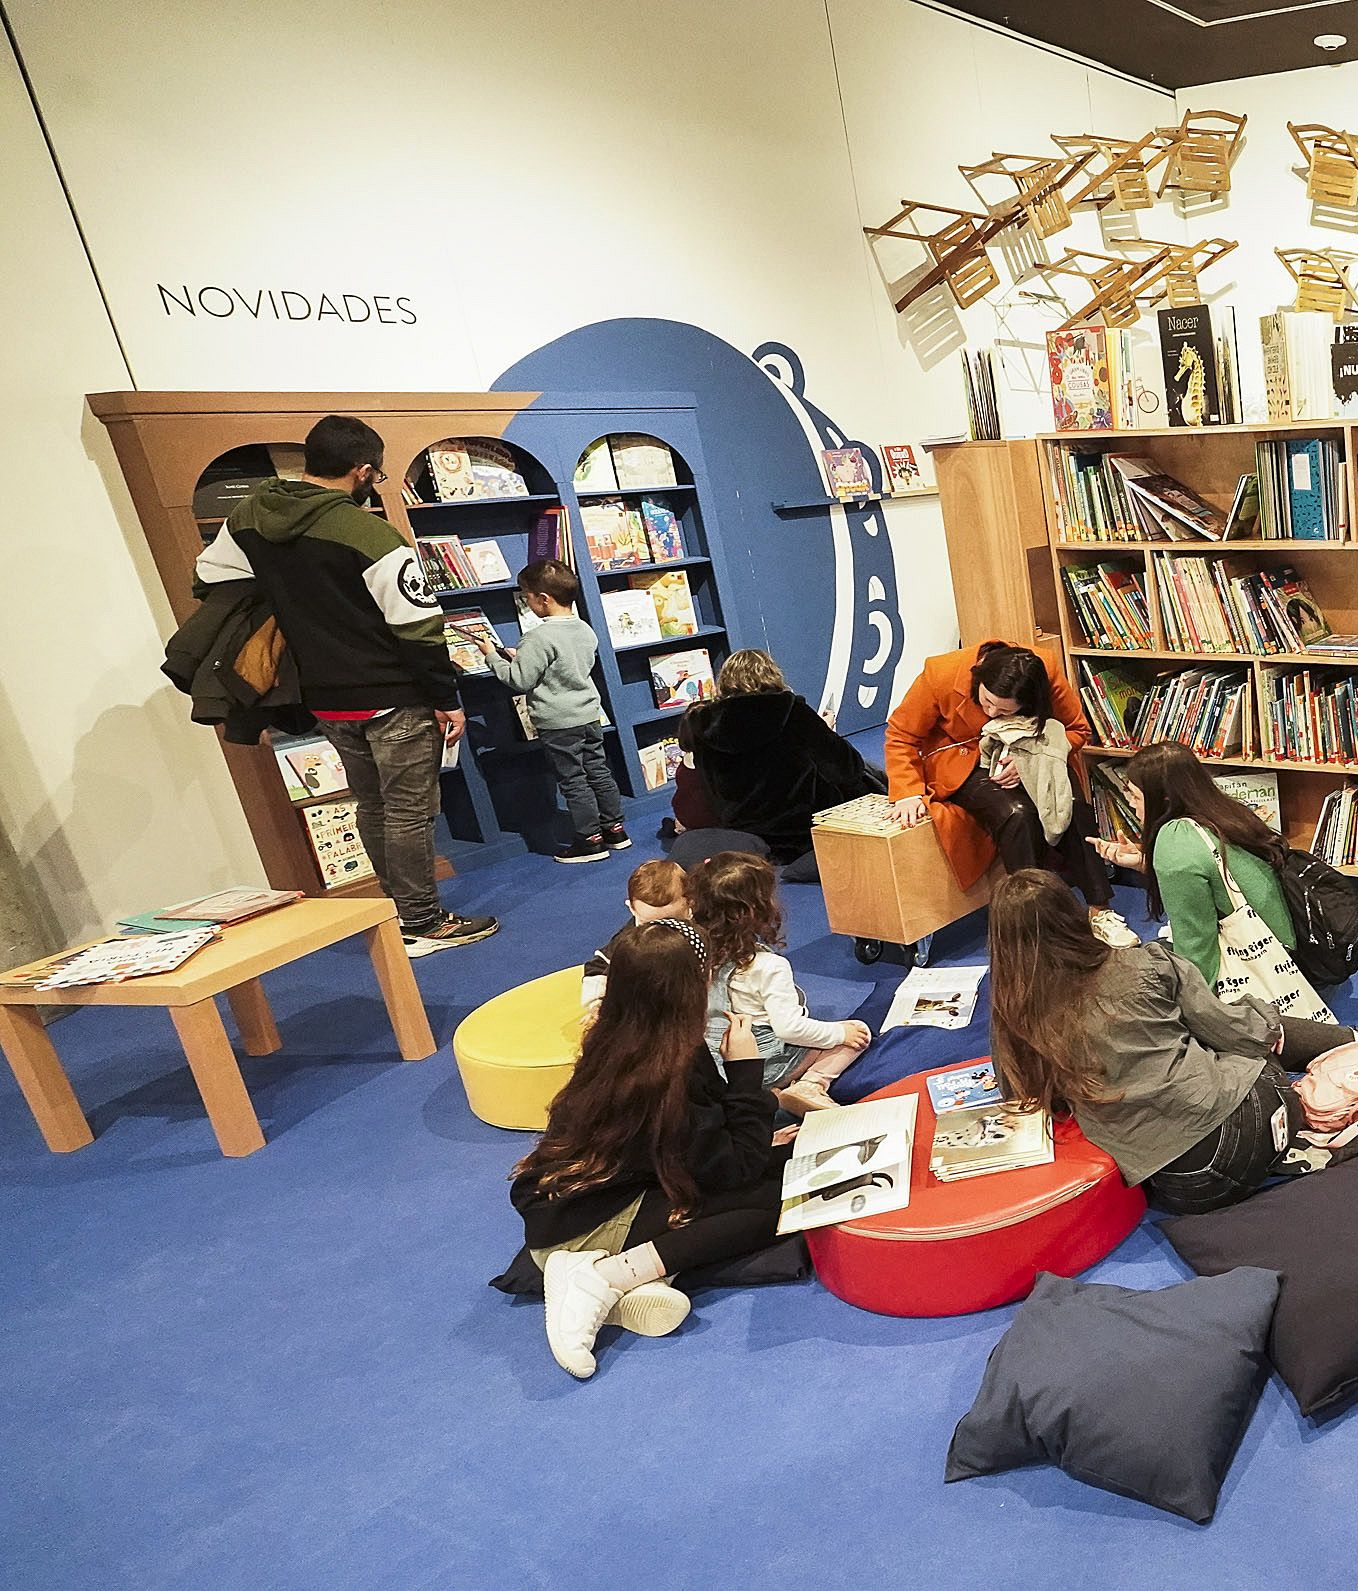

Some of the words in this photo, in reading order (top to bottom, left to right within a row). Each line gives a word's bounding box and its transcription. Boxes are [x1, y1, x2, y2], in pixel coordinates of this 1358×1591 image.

[157, 283, 417, 325] NOVIDADES
[1167, 316, 1199, 331] Nacer
[334, 803, 346, 814] AS
[1249, 936, 1273, 953] tiger
